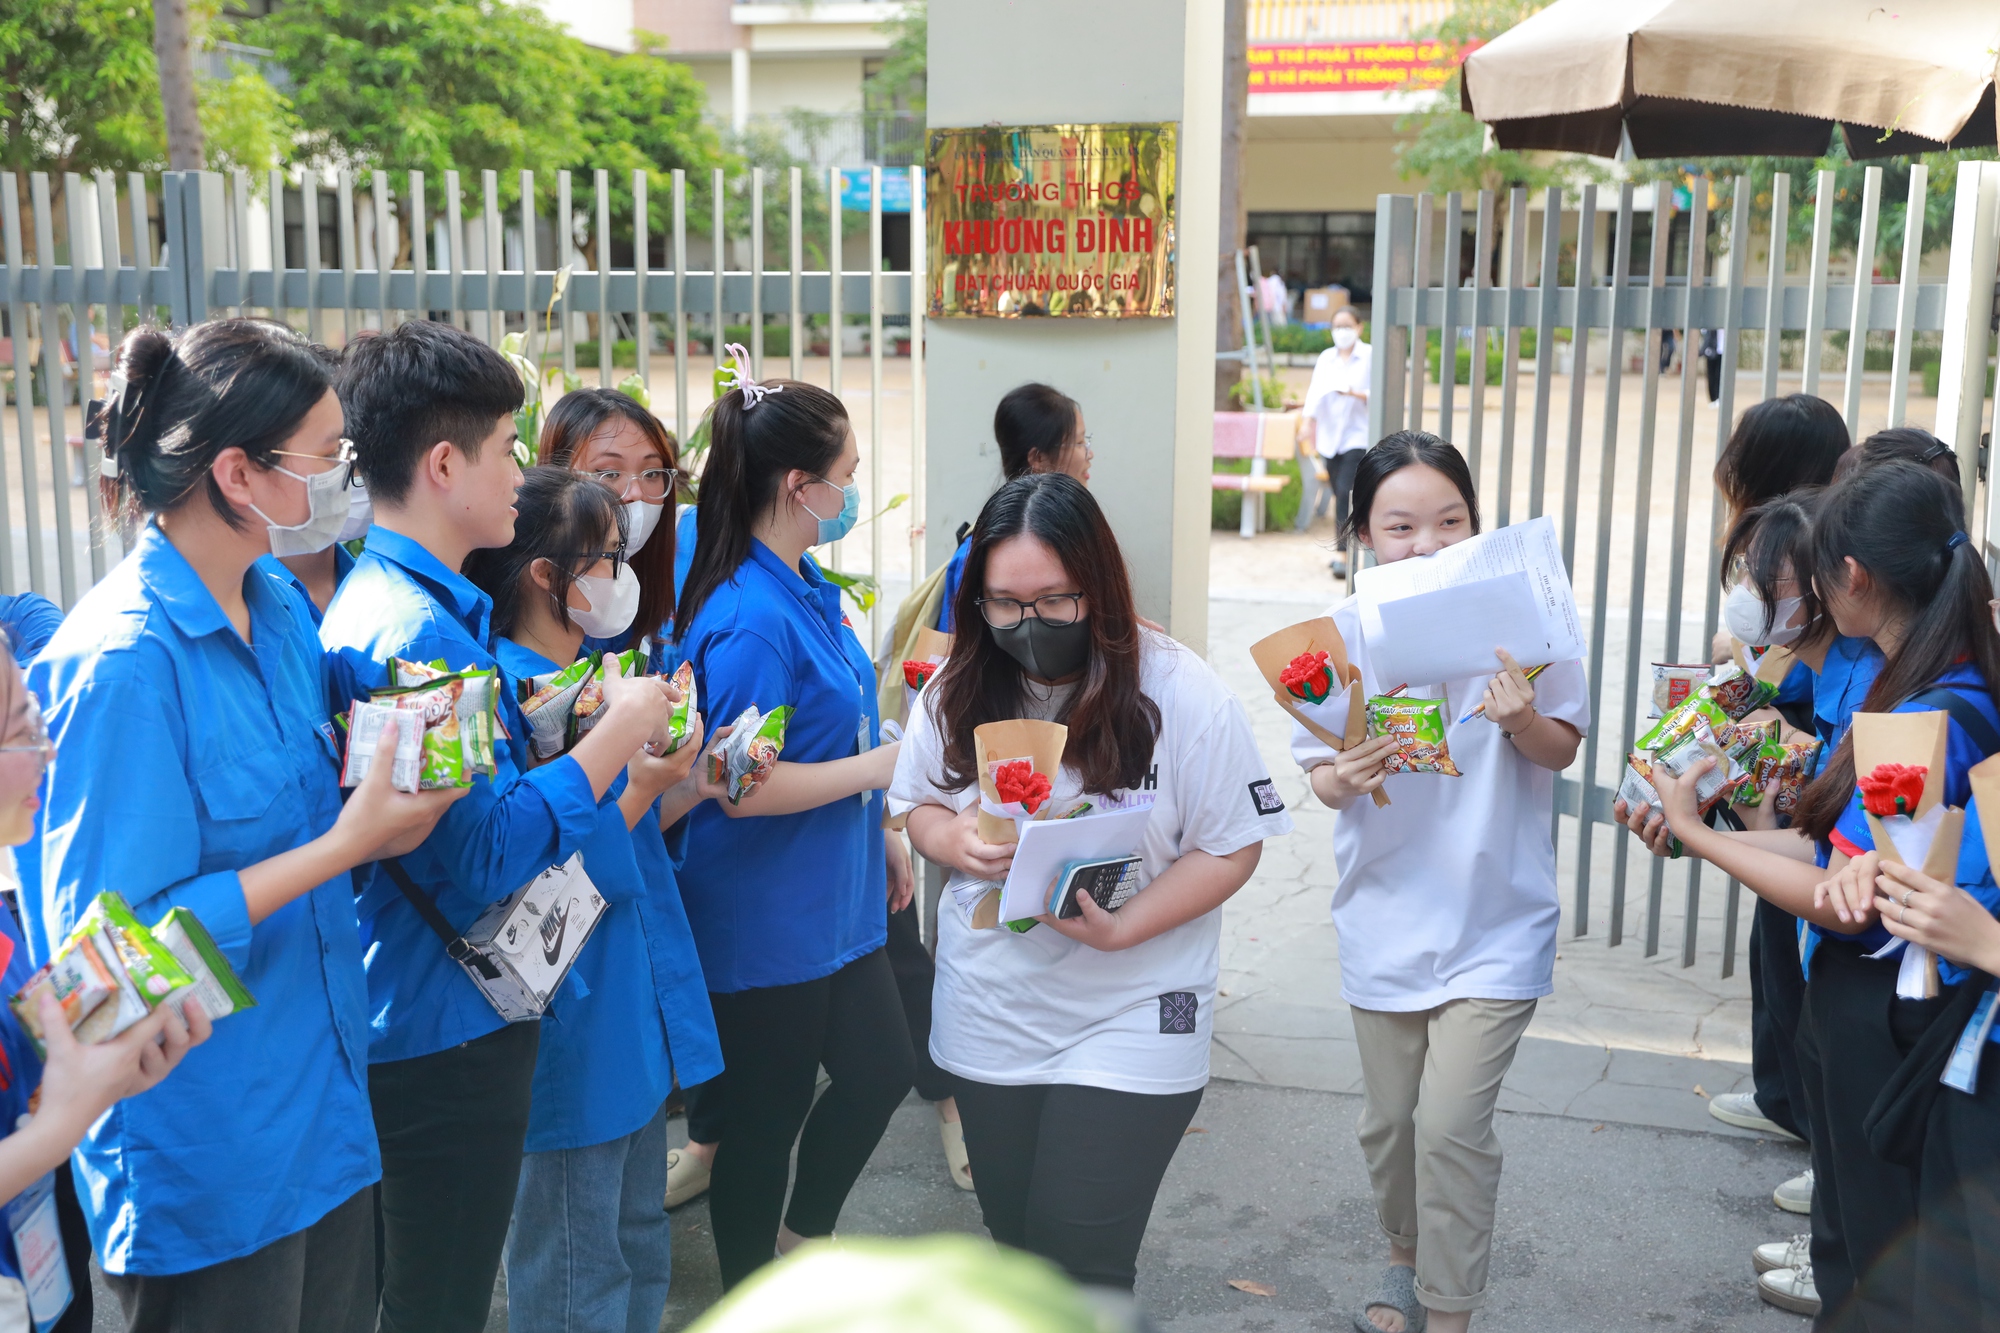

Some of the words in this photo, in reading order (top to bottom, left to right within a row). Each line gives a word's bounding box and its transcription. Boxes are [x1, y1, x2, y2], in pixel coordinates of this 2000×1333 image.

[956, 178, 1059, 203] TRƯỜNG
[1069, 181, 1141, 201] THCS
[944, 216, 1066, 255] KHƯƠNG
[1076, 211, 1153, 253] ĐÌNH
[955, 274, 987, 297] ĐẠT
[992, 262, 1050, 291] CHUẨN
[1056, 265, 1104, 291] QUỐC
[1110, 273, 1140, 291] GIA
[1384, 719, 1417, 734] Snack
[1755, 757, 1777, 793] Snack
[1098, 792, 1157, 810] QUALITY
[538, 904, 566, 949] NIKE
